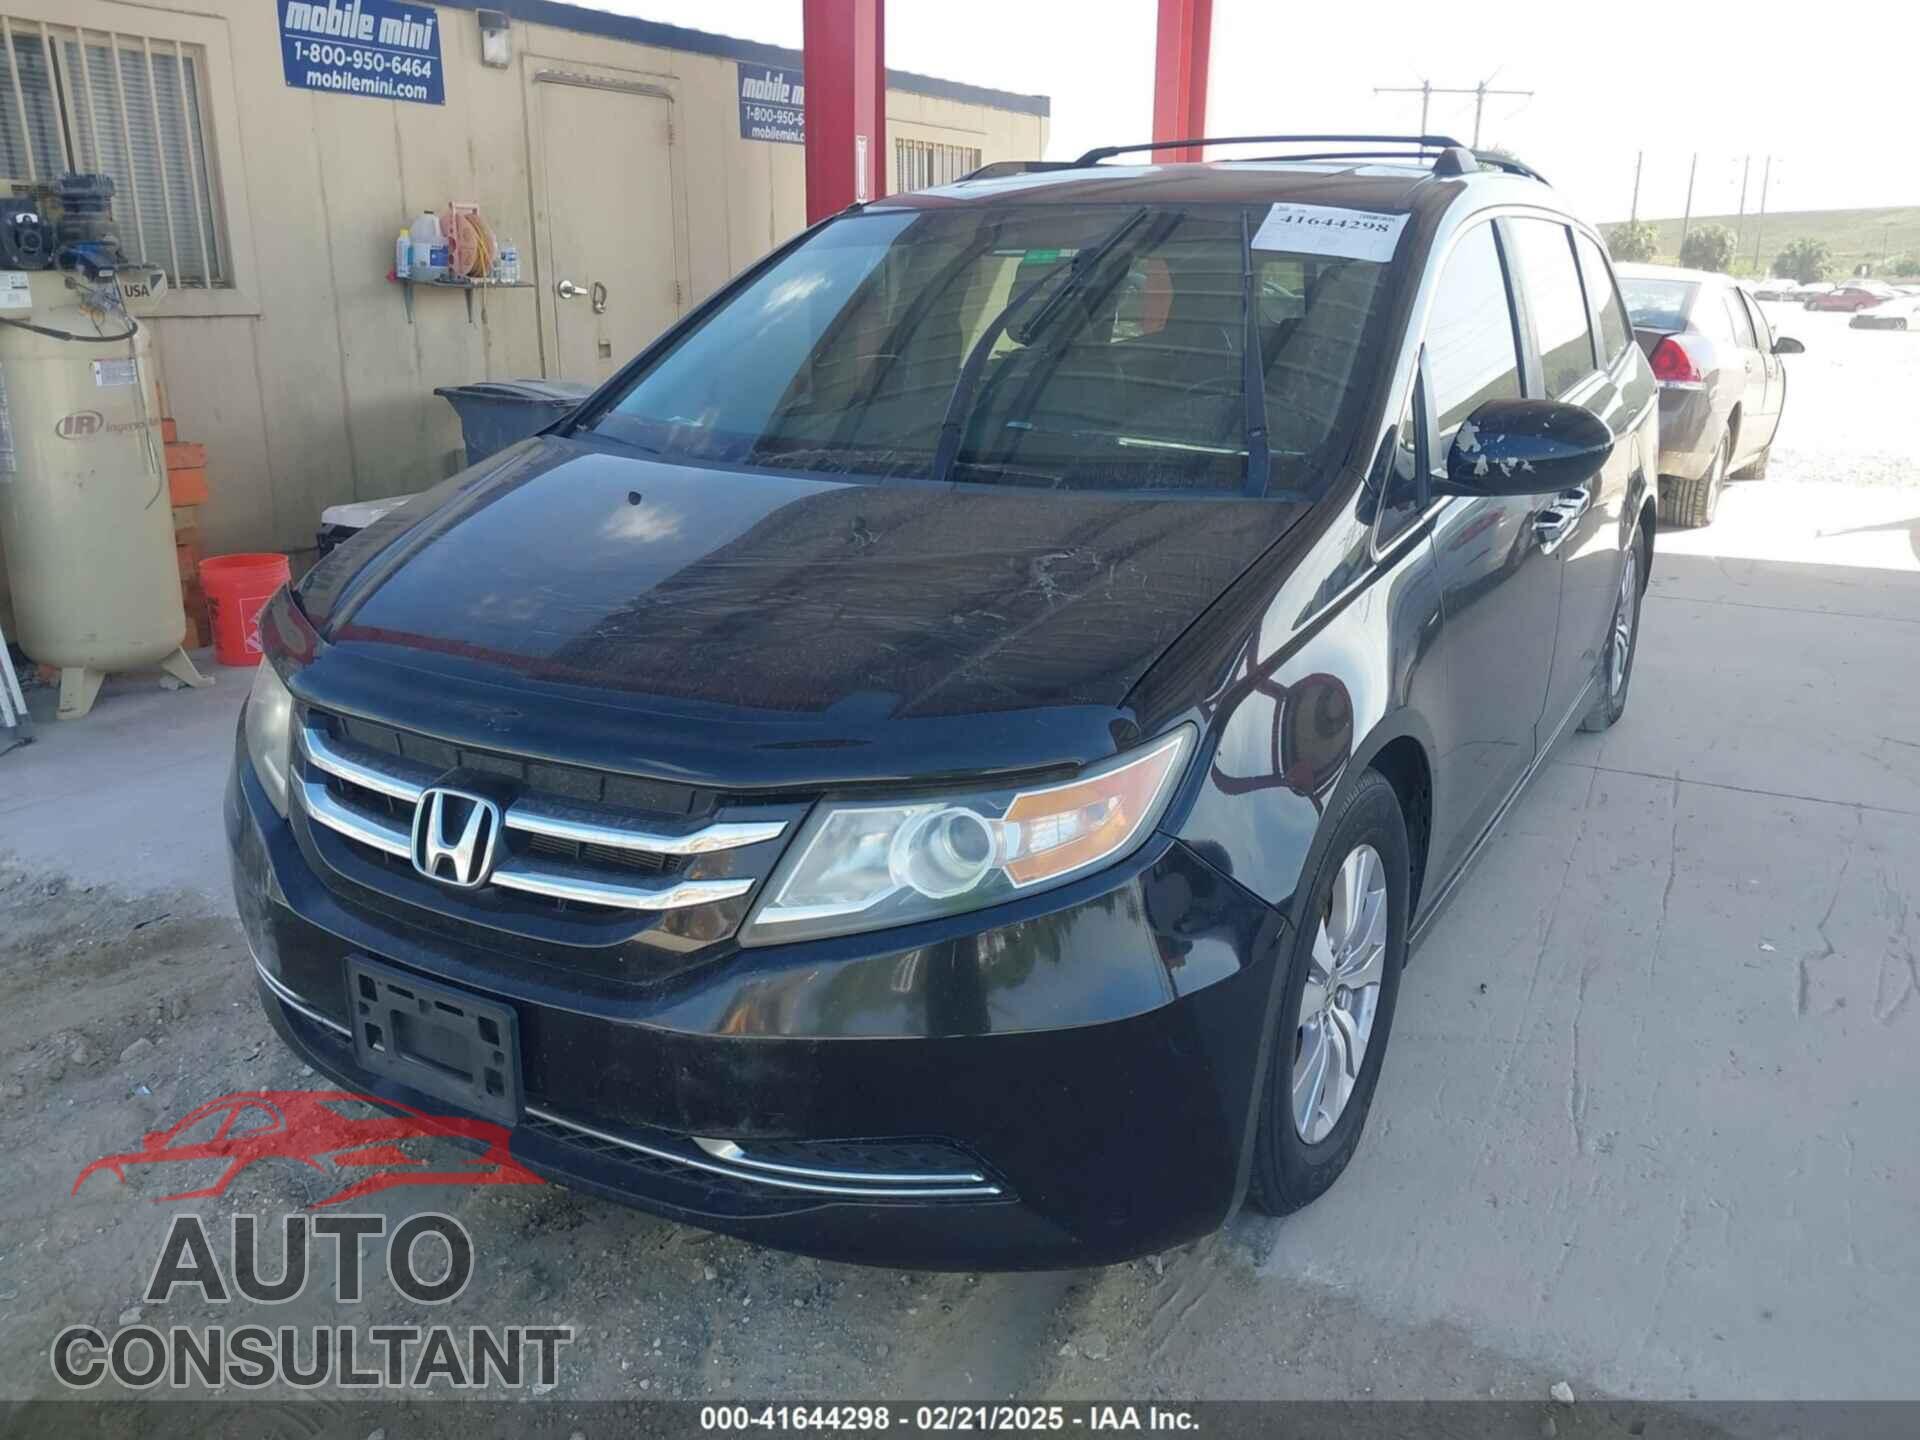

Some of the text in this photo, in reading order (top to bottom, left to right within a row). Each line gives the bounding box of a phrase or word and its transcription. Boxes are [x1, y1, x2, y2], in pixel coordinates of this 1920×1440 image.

[285, 0, 433, 50] mobile mini
[294, 41, 431, 78] 1-800-950-6464
[306, 70, 427, 99] mobilemini.com
[742, 71, 790, 103] mobile
[1280, 215, 1390, 233] 41644298
[124, 284, 150, 298] USA
[63, 416, 97, 435] IR
